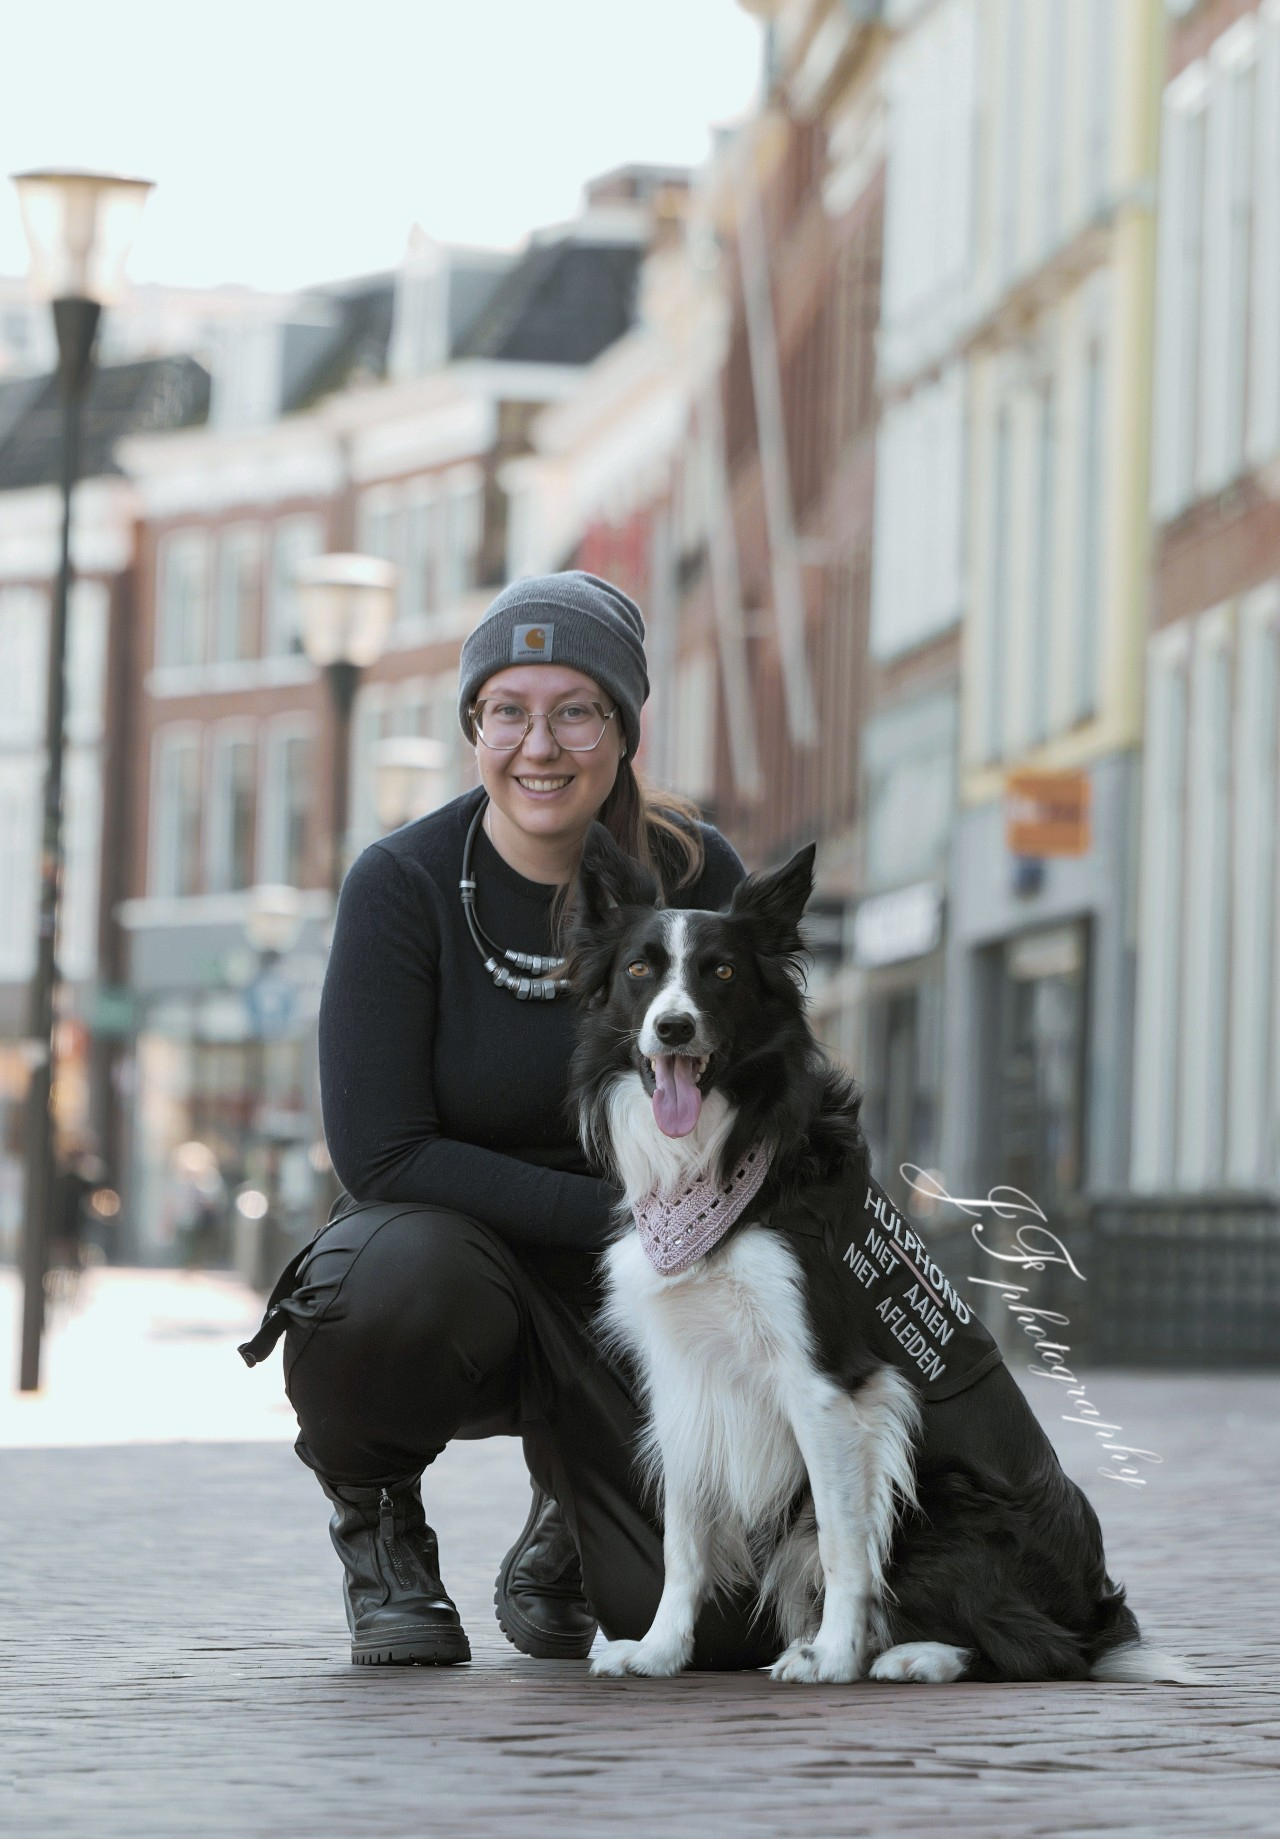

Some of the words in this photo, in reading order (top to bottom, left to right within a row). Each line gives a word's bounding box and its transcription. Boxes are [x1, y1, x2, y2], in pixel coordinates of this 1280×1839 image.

[842, 1242, 880, 1289] NIET
[875, 1296, 946, 1381] AFLEIDEN
[864, 1187, 972, 1325] HULPHOND
[864, 1228, 900, 1276] NIET
[903, 1283, 954, 1346] AAIEN
